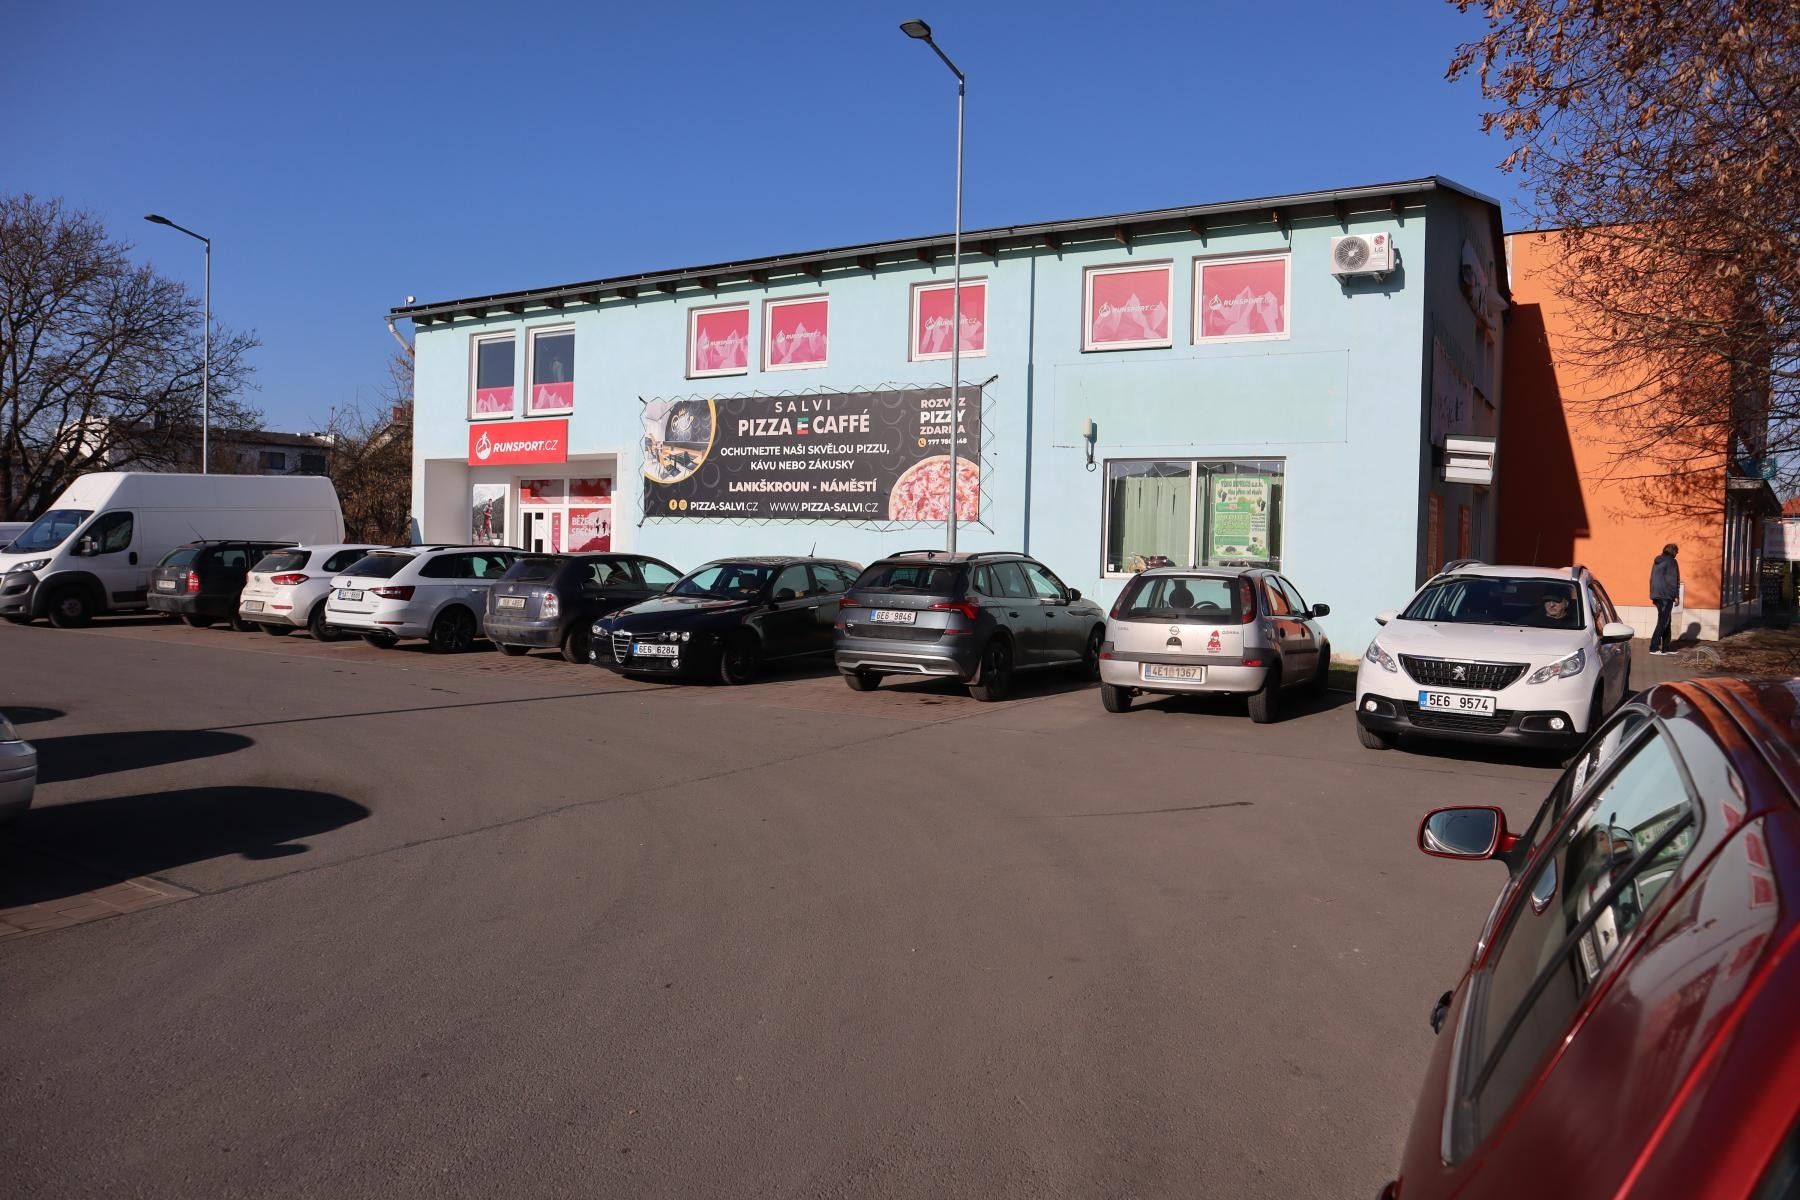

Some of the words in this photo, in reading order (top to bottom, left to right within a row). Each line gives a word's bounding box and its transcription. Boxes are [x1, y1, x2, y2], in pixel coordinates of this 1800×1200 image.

[775, 399, 831, 413] SALVI
[920, 397, 966, 408] ROZVZ
[738, 417, 793, 437] PIZZA
[812, 408, 870, 434] CAFFÉ
[920, 409, 966, 424] PIZZY
[493, 440, 559, 453] RUNSPORT.CZ
[720, 446, 781, 457] OCHUTNEJTE
[783, 443, 806, 455] NAŠI
[807, 442, 855, 455] SKVĚLOU
[856, 443, 890, 455] PIZZU,
[750, 459, 776, 471] KÁVU
[778, 460, 806, 470] NEBO
[808, 458, 855, 470] ZÁKUSKY
[728, 479, 810, 492] LANKŠKROUN
[820, 478, 878, 492] NÁMĚSTÍ
[690, 501, 759, 512] PIZZA-SALVI.CZ
[769, 502, 879, 513] WWW.PIZZA-SALVI.CZ
[656, 646, 675, 654] 6284
[1152, 667, 1168, 676] 4E1
[1175, 668, 1197, 678] 1367
[1429, 694, 1451, 707] 5E6
[1459, 697, 1489, 711] 9574
